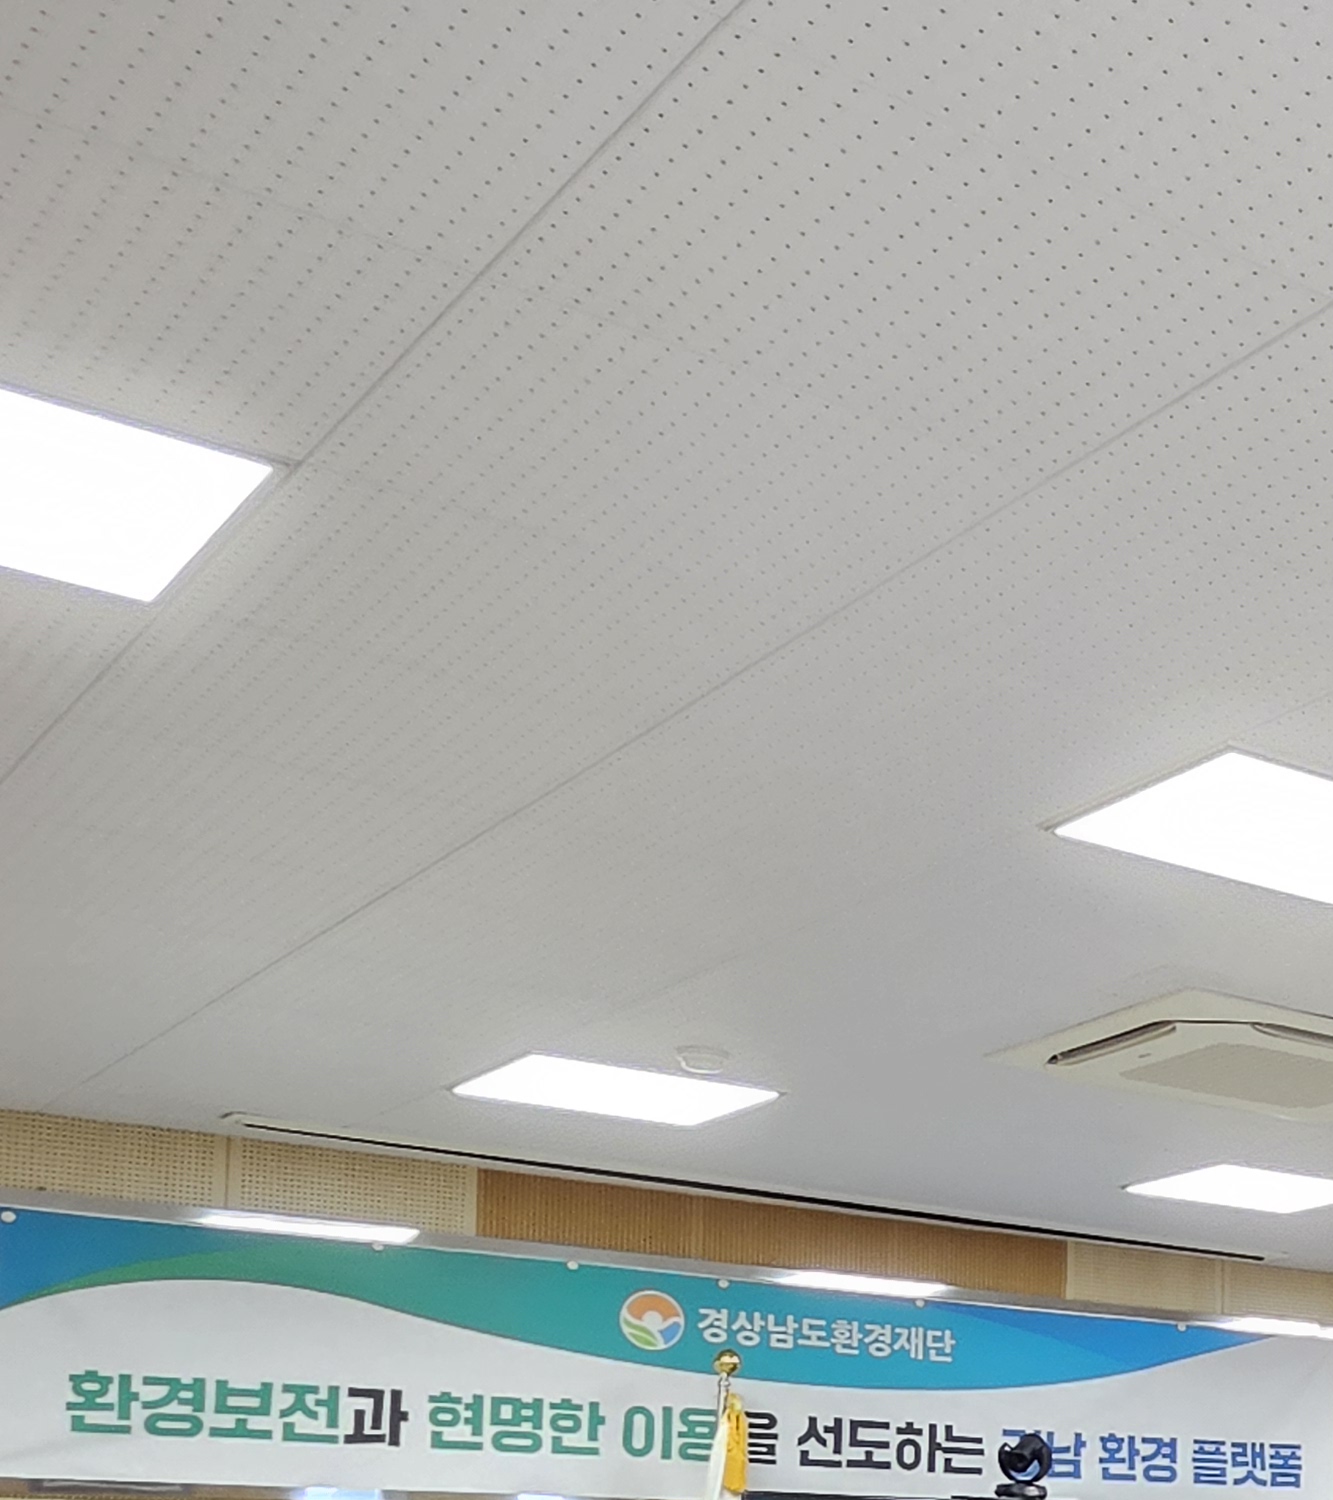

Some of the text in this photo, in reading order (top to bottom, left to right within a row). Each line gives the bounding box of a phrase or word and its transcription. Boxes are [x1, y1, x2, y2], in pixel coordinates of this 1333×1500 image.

[697, 1307, 956, 1362] 경상남도환경재단
[65, 1369, 409, 1447] 환경보전과
[426, 1391, 605, 1457] 현명한
[622, 1405, 778, 1465] 이용을
[797, 1416, 984, 1475] 선도하는
[1098, 1433, 1179, 1484] 환경
[1192, 1438, 1302, 1489] 플랫폼
